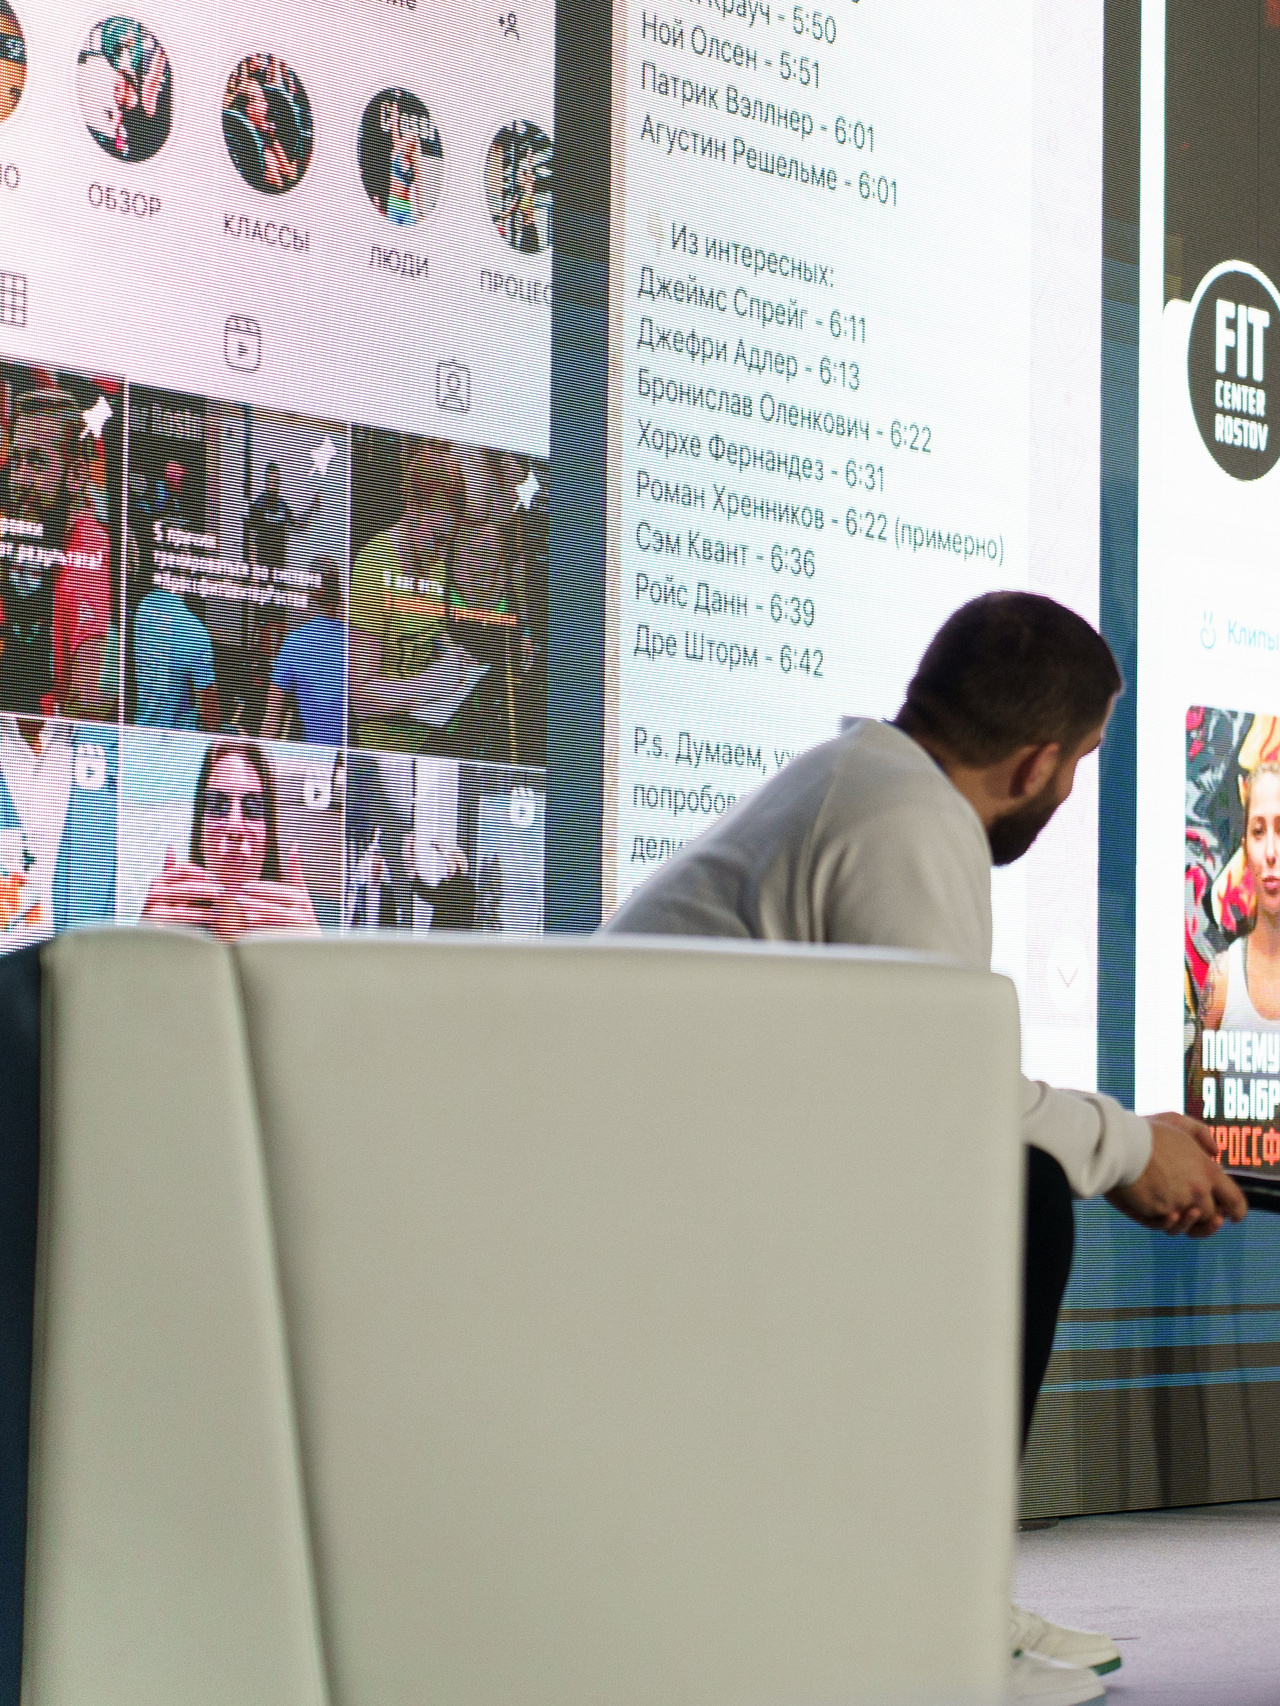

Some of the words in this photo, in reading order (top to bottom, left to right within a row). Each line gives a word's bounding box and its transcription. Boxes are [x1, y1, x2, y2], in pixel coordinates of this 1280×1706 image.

[642, 12, 684, 49] Ной
[691, 26, 757, 71] Олсен
[780, 51, 820, 88] 5:51
[793, 6, 836, 44] 5:50
[641, 60, 718, 109] Патрик
[726, 85, 814, 140] Вэллнер
[835, 116, 874, 152] 6:01
[641, 114, 726, 161] Агустин
[733, 136, 837, 191] Решельме
[859, 171, 897, 206] 6:01
[88, 182, 161, 217] ОБЗОР
[223, 213, 310, 254] КЛАССЫ
[672, 222, 699, 255] Из
[705, 236, 834, 287] интересных:
[370, 246, 429, 280] ЛЮДИ
[638, 264, 727, 312] Джеймс
[733, 287, 808, 329] Спрейг
[830, 309, 866, 343] 6:11
[637, 315, 727, 365] Джефри
[734, 338, 798, 382] Адлер
[820, 355, 860, 390] 6:13
[1215, 298, 1271, 384] FIT
[638, 367, 753, 418] Бронислав
[760, 394, 870, 441] Оленкович
[890, 420, 932, 453] 6:22
[1215, 378, 1266, 418] CENTER
[637, 419, 701, 459] Хорхе
[708, 434, 824, 481] Фернандез
[845, 457, 884, 492] 6:31
[1215, 412, 1269, 452] ROSTOV
[636, 470, 706, 508] Роман
[713, 483, 825, 530] Хренников
[845, 508, 888, 541] 6:22
[895, 516, 1004, 566] (примерно)
[636, 522, 681, 555] Сэм
[688, 530, 750, 566] Квант
[771, 544, 816, 578] 6:36
[636, 573, 688, 607] Ройс
[694, 582, 748, 617] Данн
[770, 593, 815, 627] 6:39
[633, 624, 678, 662] Дре
[685, 630, 758, 672] Шторм
[780, 644, 824, 677] 6:42
[1227, 619, 1279, 651] Клипы
[676, 732, 766, 775] Думаем,
[1202, 1030, 1280, 1074] ПОЧЕМУ
[1202, 1077, 1217, 1119] Я
